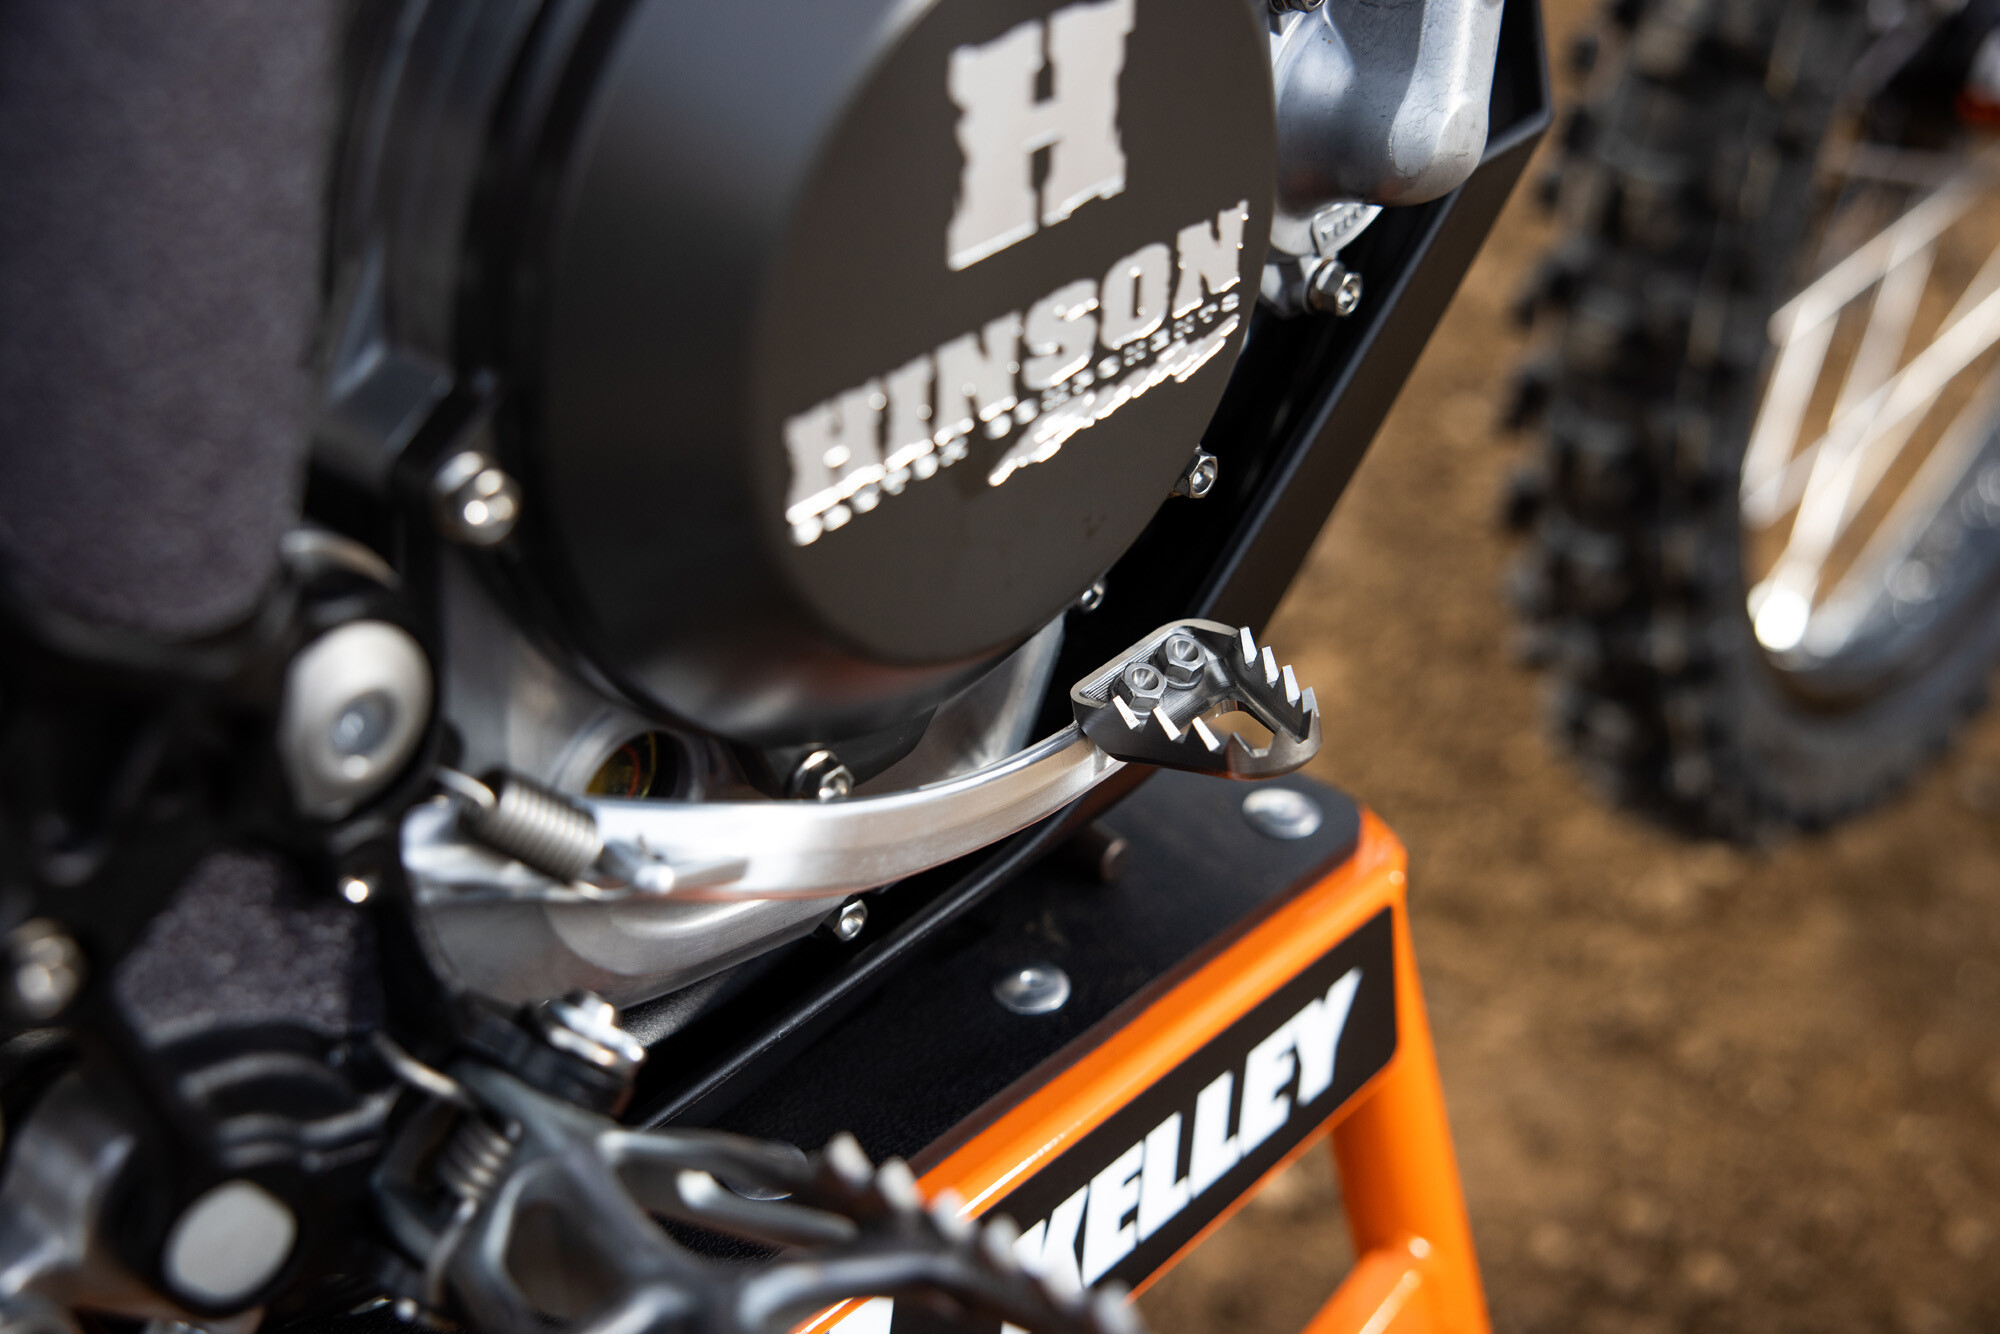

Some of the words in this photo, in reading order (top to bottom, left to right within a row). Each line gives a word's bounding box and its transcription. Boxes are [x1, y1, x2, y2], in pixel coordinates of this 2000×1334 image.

[947, 0, 1137, 271] H
[783, 200, 1249, 525] HINSON
[1002, 966, 1362, 1334] KELLEY
